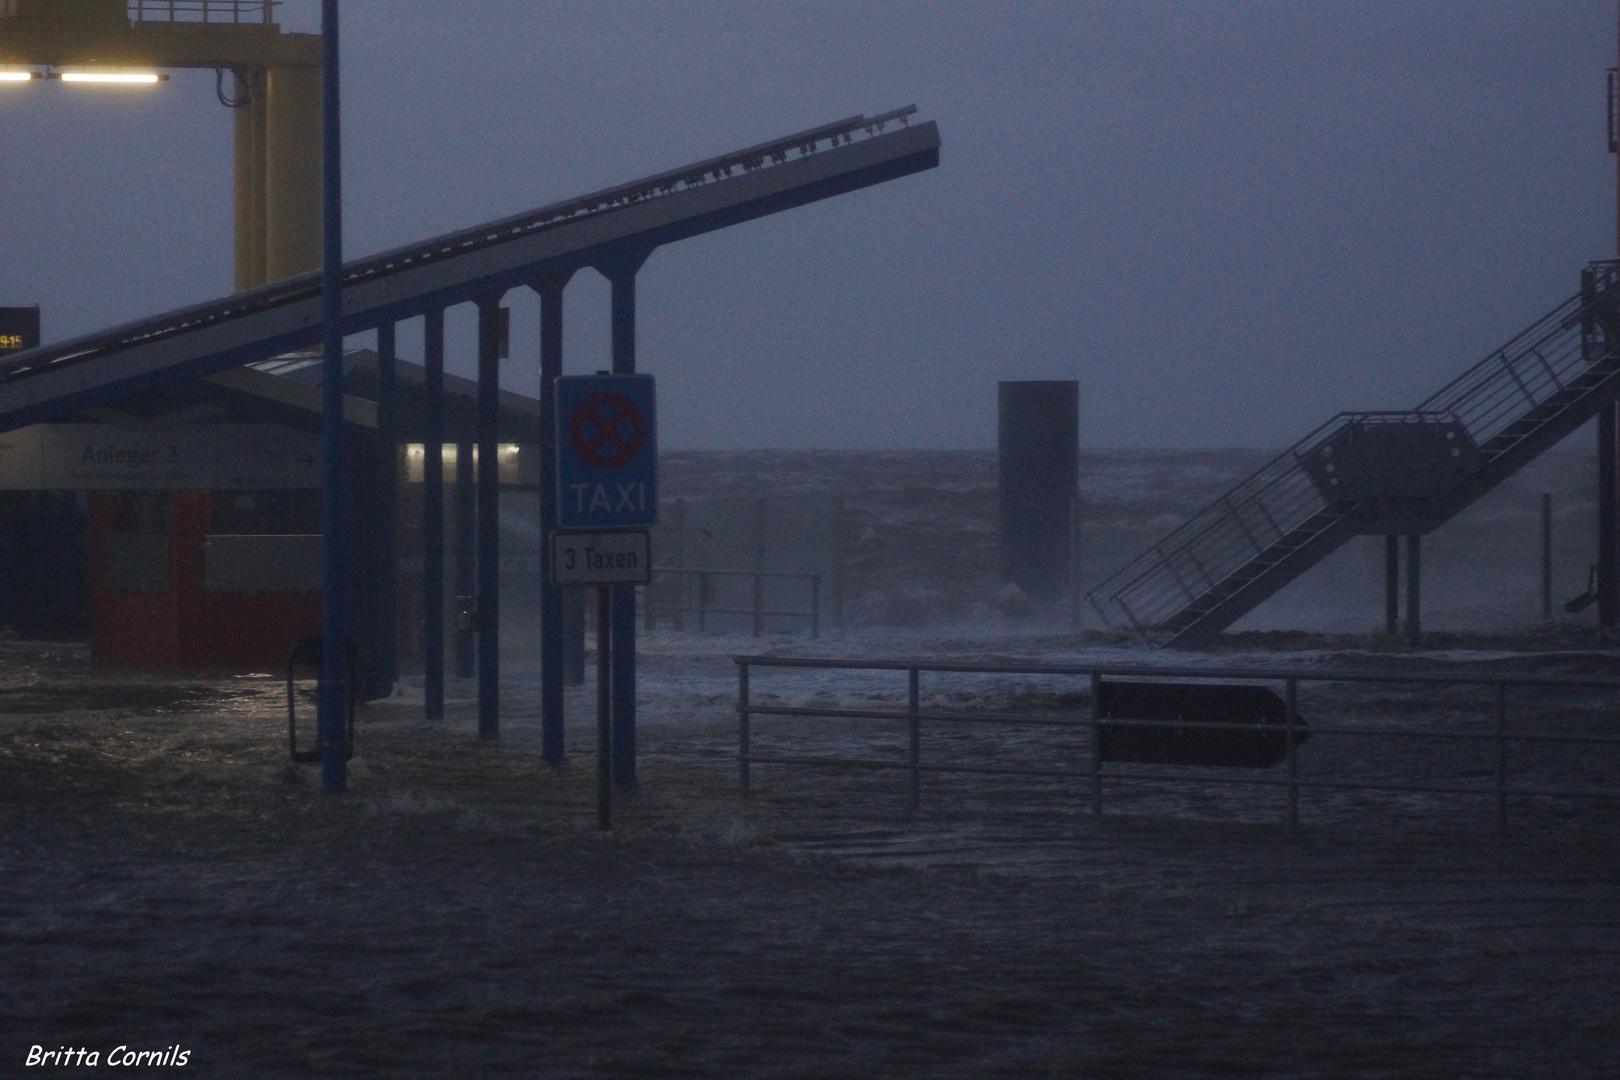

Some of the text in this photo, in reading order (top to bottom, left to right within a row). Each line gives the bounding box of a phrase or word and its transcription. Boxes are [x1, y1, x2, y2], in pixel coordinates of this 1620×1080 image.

[82, 445, 178, 468] Anleger 3
[571, 482, 646, 514] TAXI
[565, 547, 638, 570] 3 Taxen
